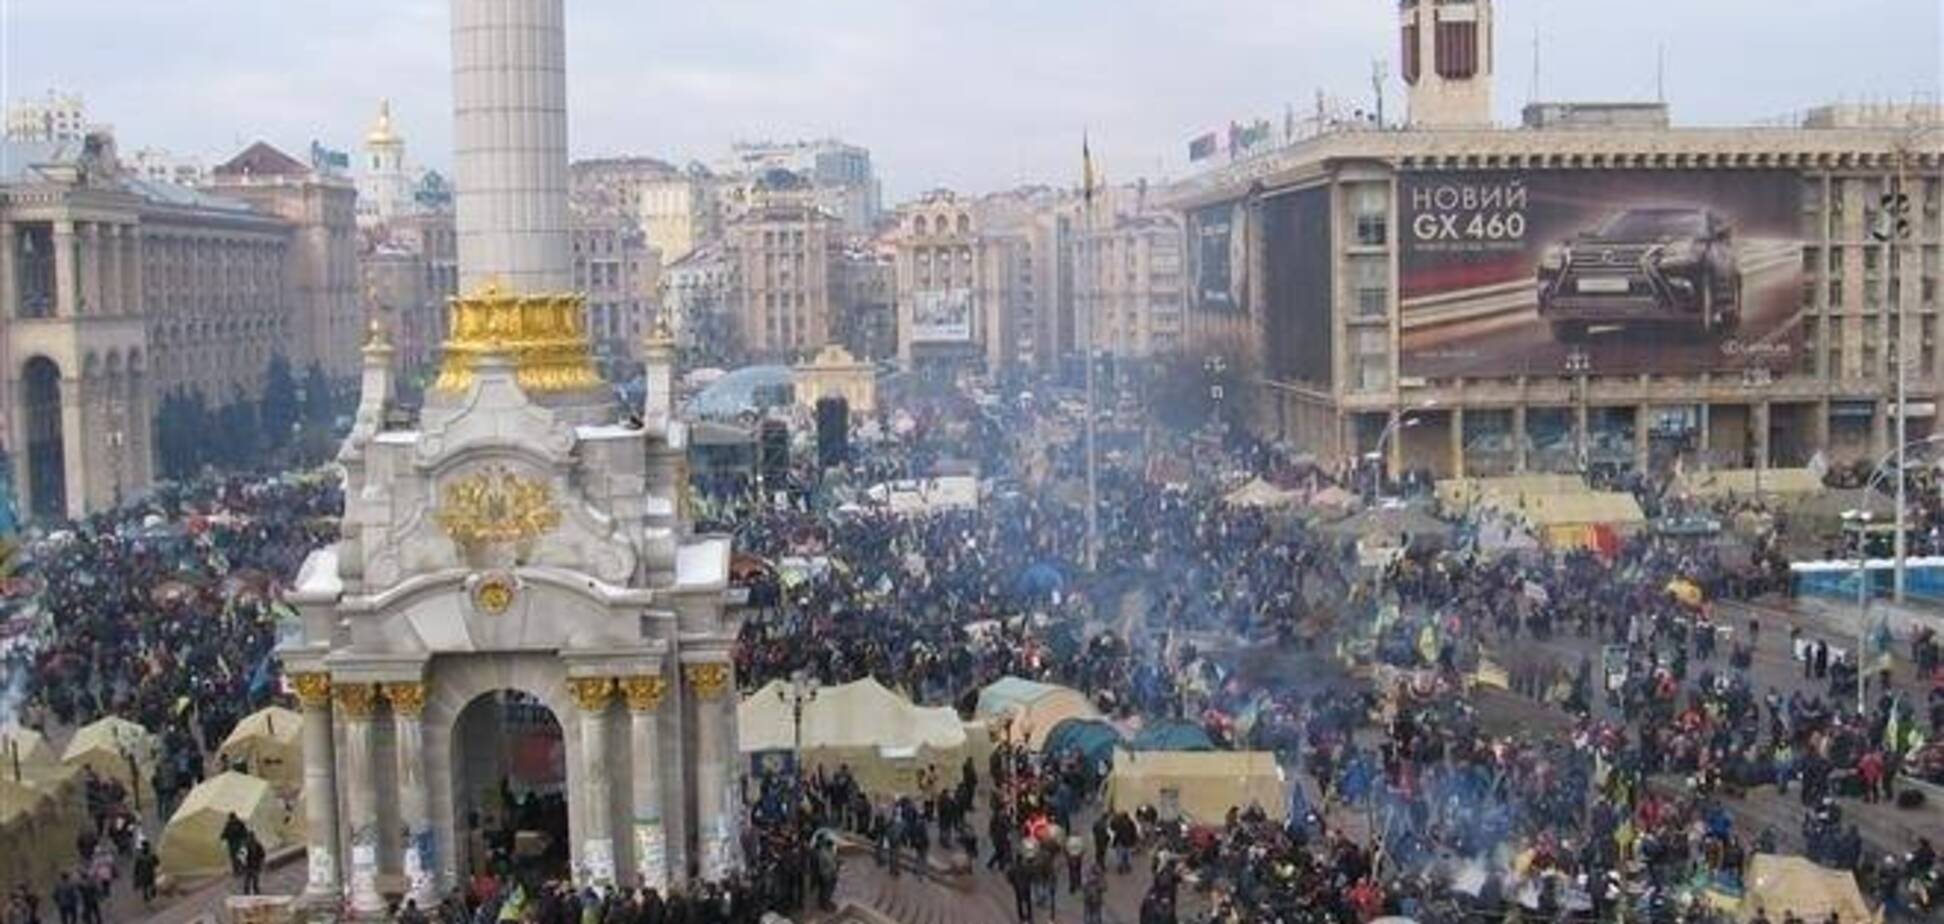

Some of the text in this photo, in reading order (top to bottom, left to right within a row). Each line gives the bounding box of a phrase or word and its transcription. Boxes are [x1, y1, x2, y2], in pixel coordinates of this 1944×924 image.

[1412, 180, 1528, 210] НОВИЙ
[1413, 211, 1525, 240] GX 460
